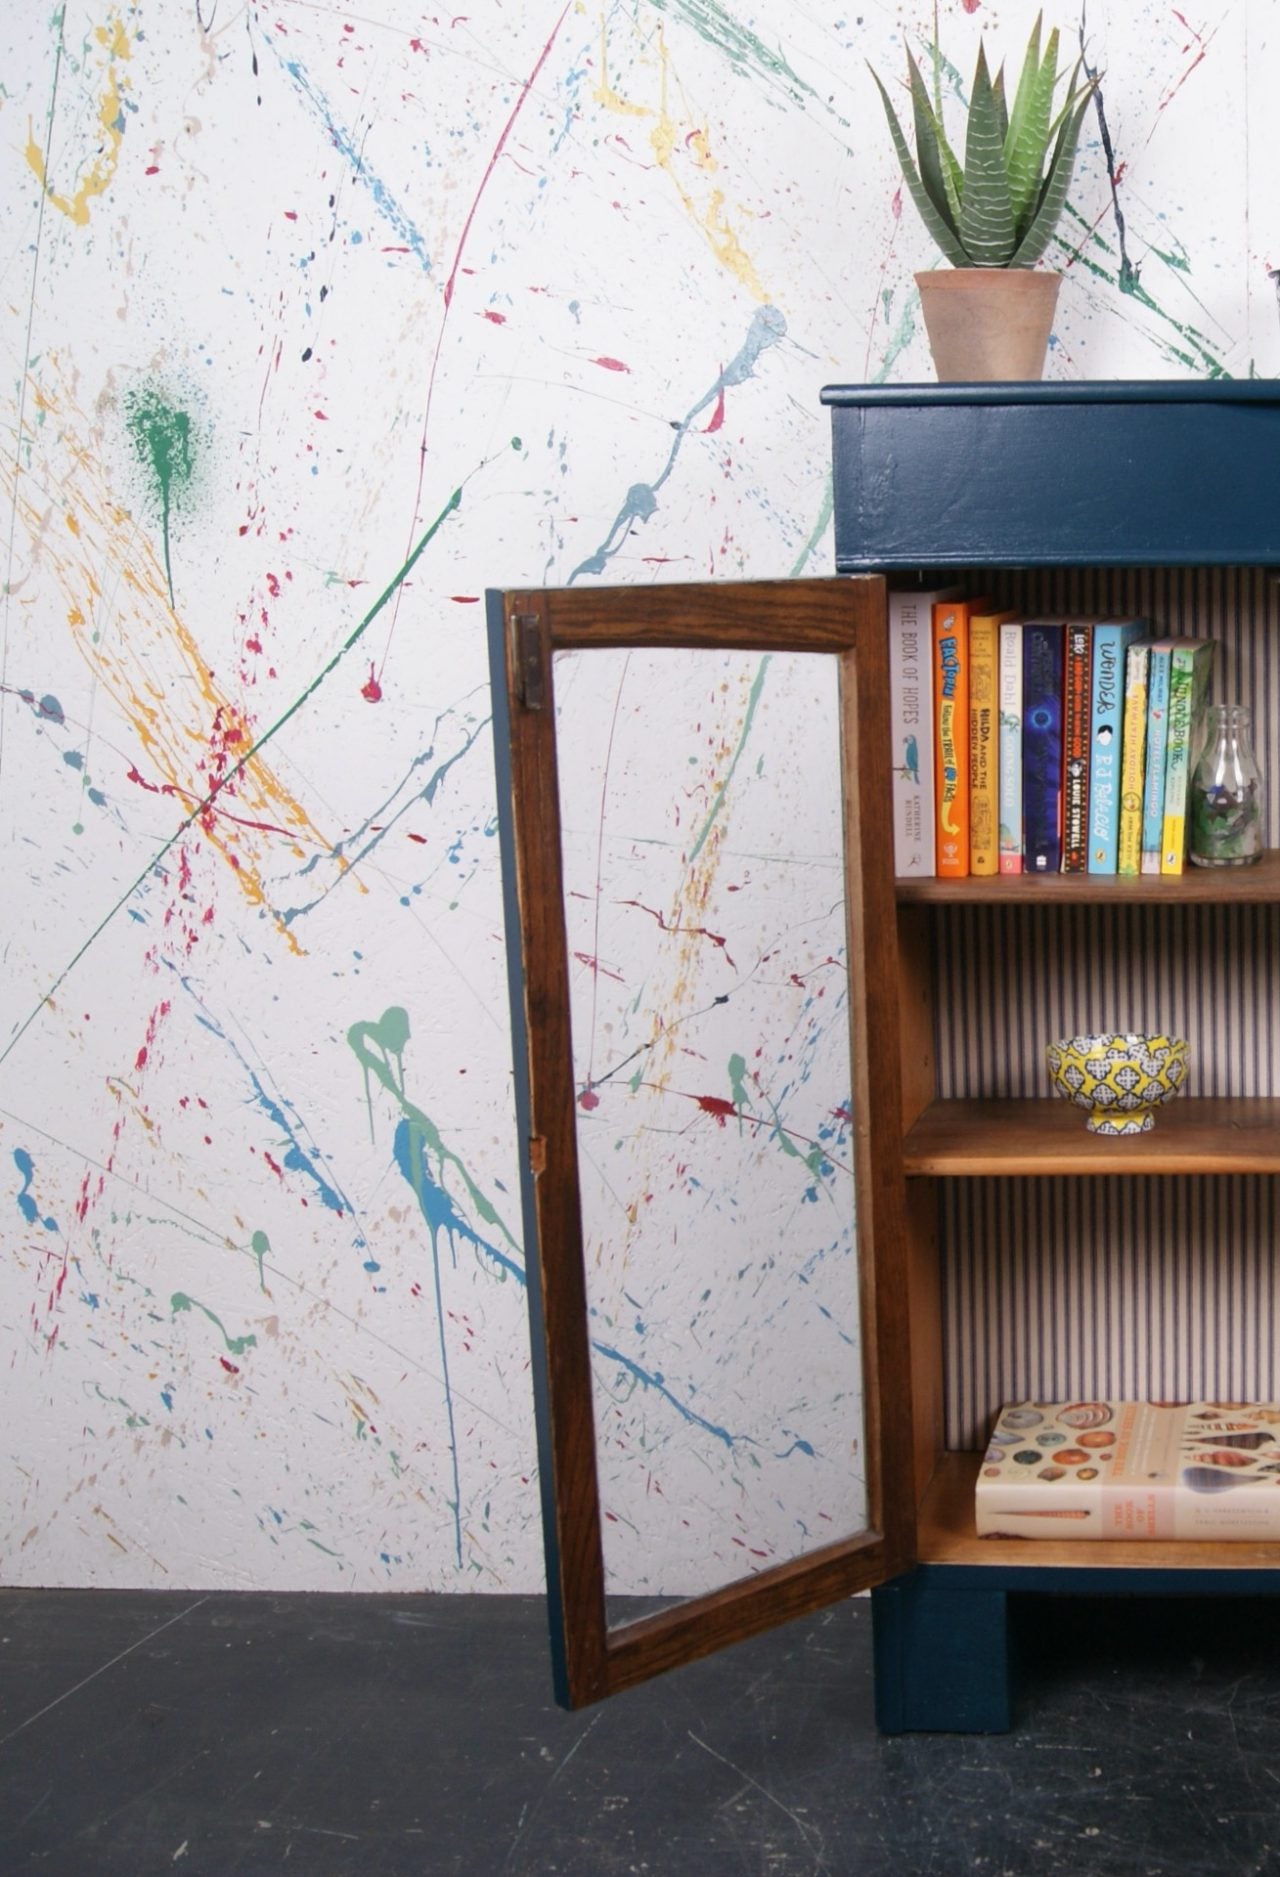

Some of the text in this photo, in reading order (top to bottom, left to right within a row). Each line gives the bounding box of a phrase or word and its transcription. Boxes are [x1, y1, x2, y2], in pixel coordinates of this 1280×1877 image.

[901, 603, 920, 724] THE BOOK OF HOPES
[1004, 631, 1017, 706] Roald Dahl
[1097, 641, 1116, 715] WONDER
[971, 708, 979, 750] HIDDEN
[979, 708, 991, 790] HILDA AND THE
[1128, 694, 1140, 790] HOLIDAY HEATWAVE
[1171, 729, 1186, 769] BOOK
[1071, 779, 1081, 849] LOUIE STOWELL
[1150, 764, 1161, 818] FLAMINGO
